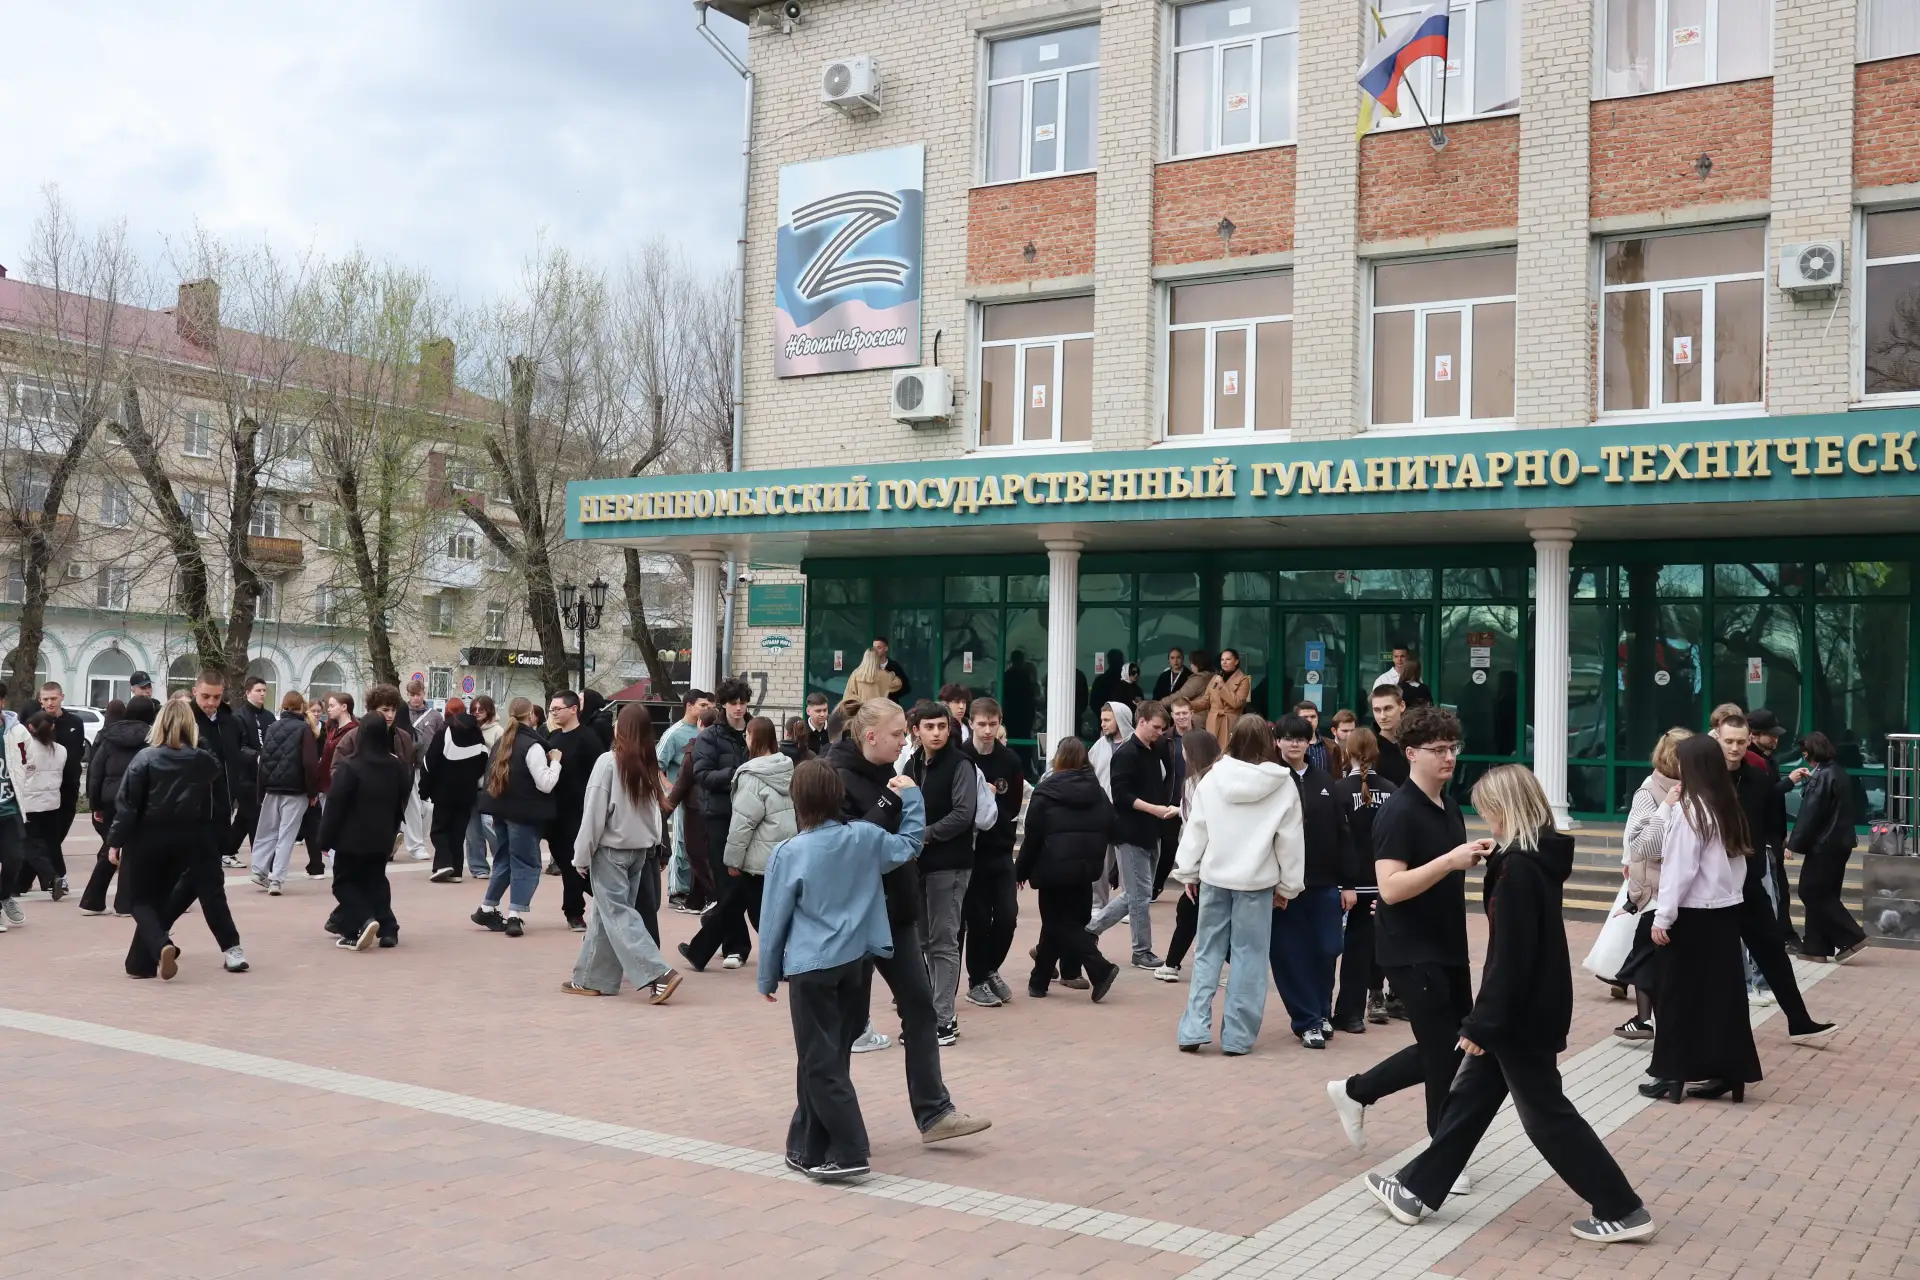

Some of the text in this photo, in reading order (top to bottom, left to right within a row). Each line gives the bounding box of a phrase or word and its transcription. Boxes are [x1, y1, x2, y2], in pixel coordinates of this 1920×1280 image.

[792, 190, 910, 300] Z
[784, 327, 908, 359] #СвоихНеБросаем
[577, 431, 1920, 524] НЕВИННОМЫССКИЙ ГОСУДАРСТВЕННЫЙ ГУМАНИТАРНО-ТЕХНИЧЕСК
[517, 653, 544, 665] билай
[740, 671, 768, 717] 7
